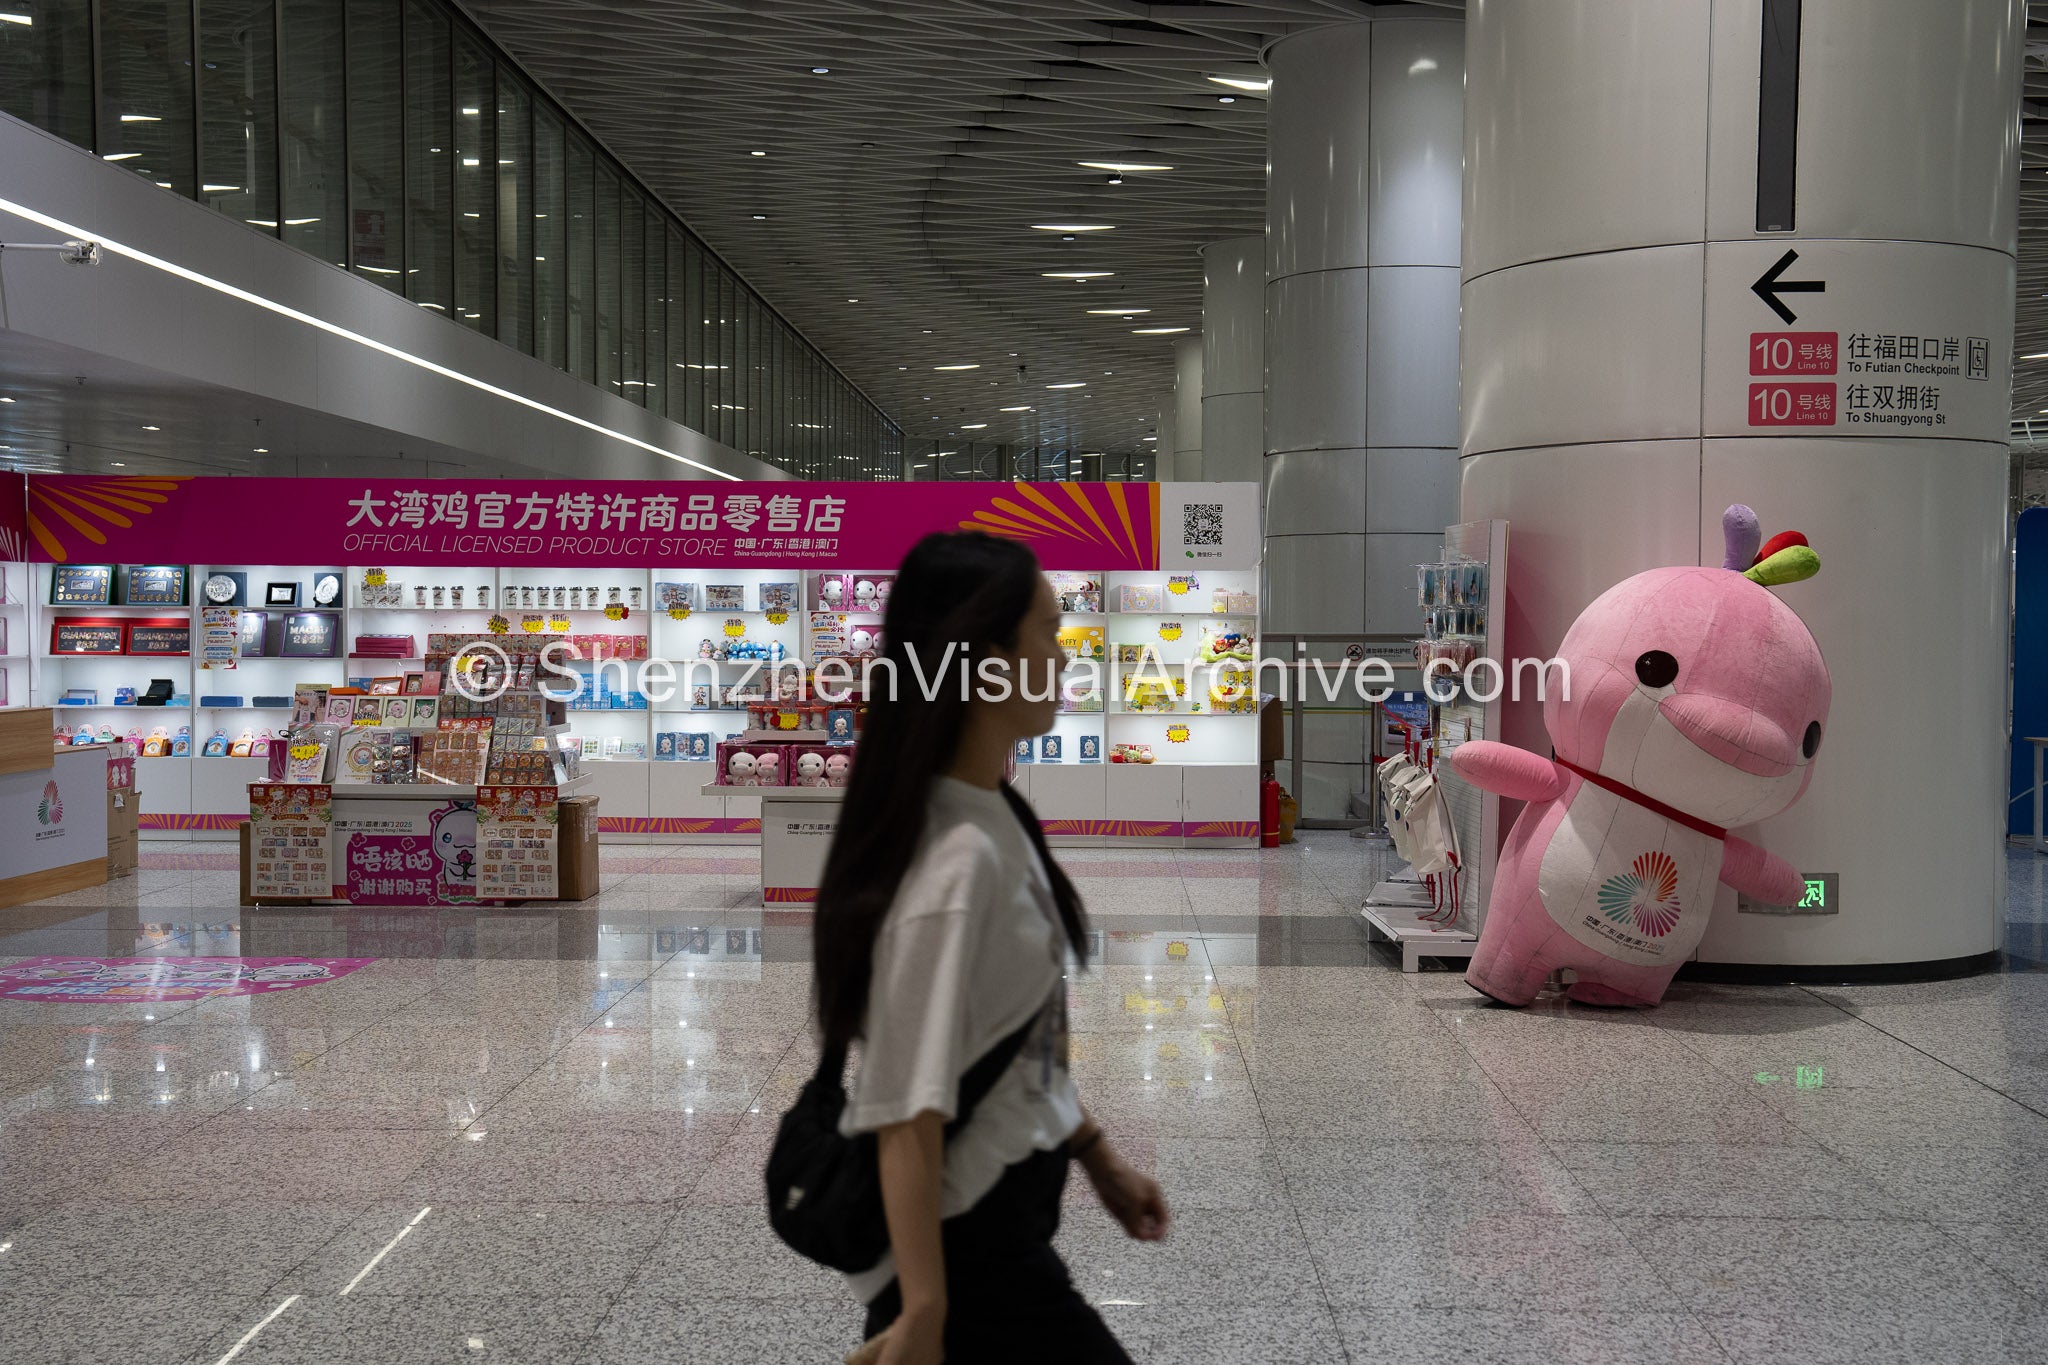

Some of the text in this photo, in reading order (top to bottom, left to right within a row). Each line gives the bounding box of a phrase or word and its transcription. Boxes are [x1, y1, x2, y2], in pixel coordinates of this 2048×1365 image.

[1755, 338, 1833, 369] 10 号线
[1848, 333, 1960, 362] 往福田口岸
[1798, 362, 1830, 370] Line 10
[1847, 361, 1960, 376] To Futian Checkpoint
[1754, 388, 1831, 420] 10 号线
[1846, 383, 1941, 411] 往双拥街
[1796, 412, 1828, 420] Line 10
[1846, 412, 1946, 426] To Shuangyong St
[346, 489, 846, 533] 大湾鸡官方特许商品零售店
[343, 533, 728, 556] OFFICIAL LICENSED PRODUCT STORE
[352, 845, 433, 872] 唔该晒
[359, 878, 432, 896] 谢谢购买
